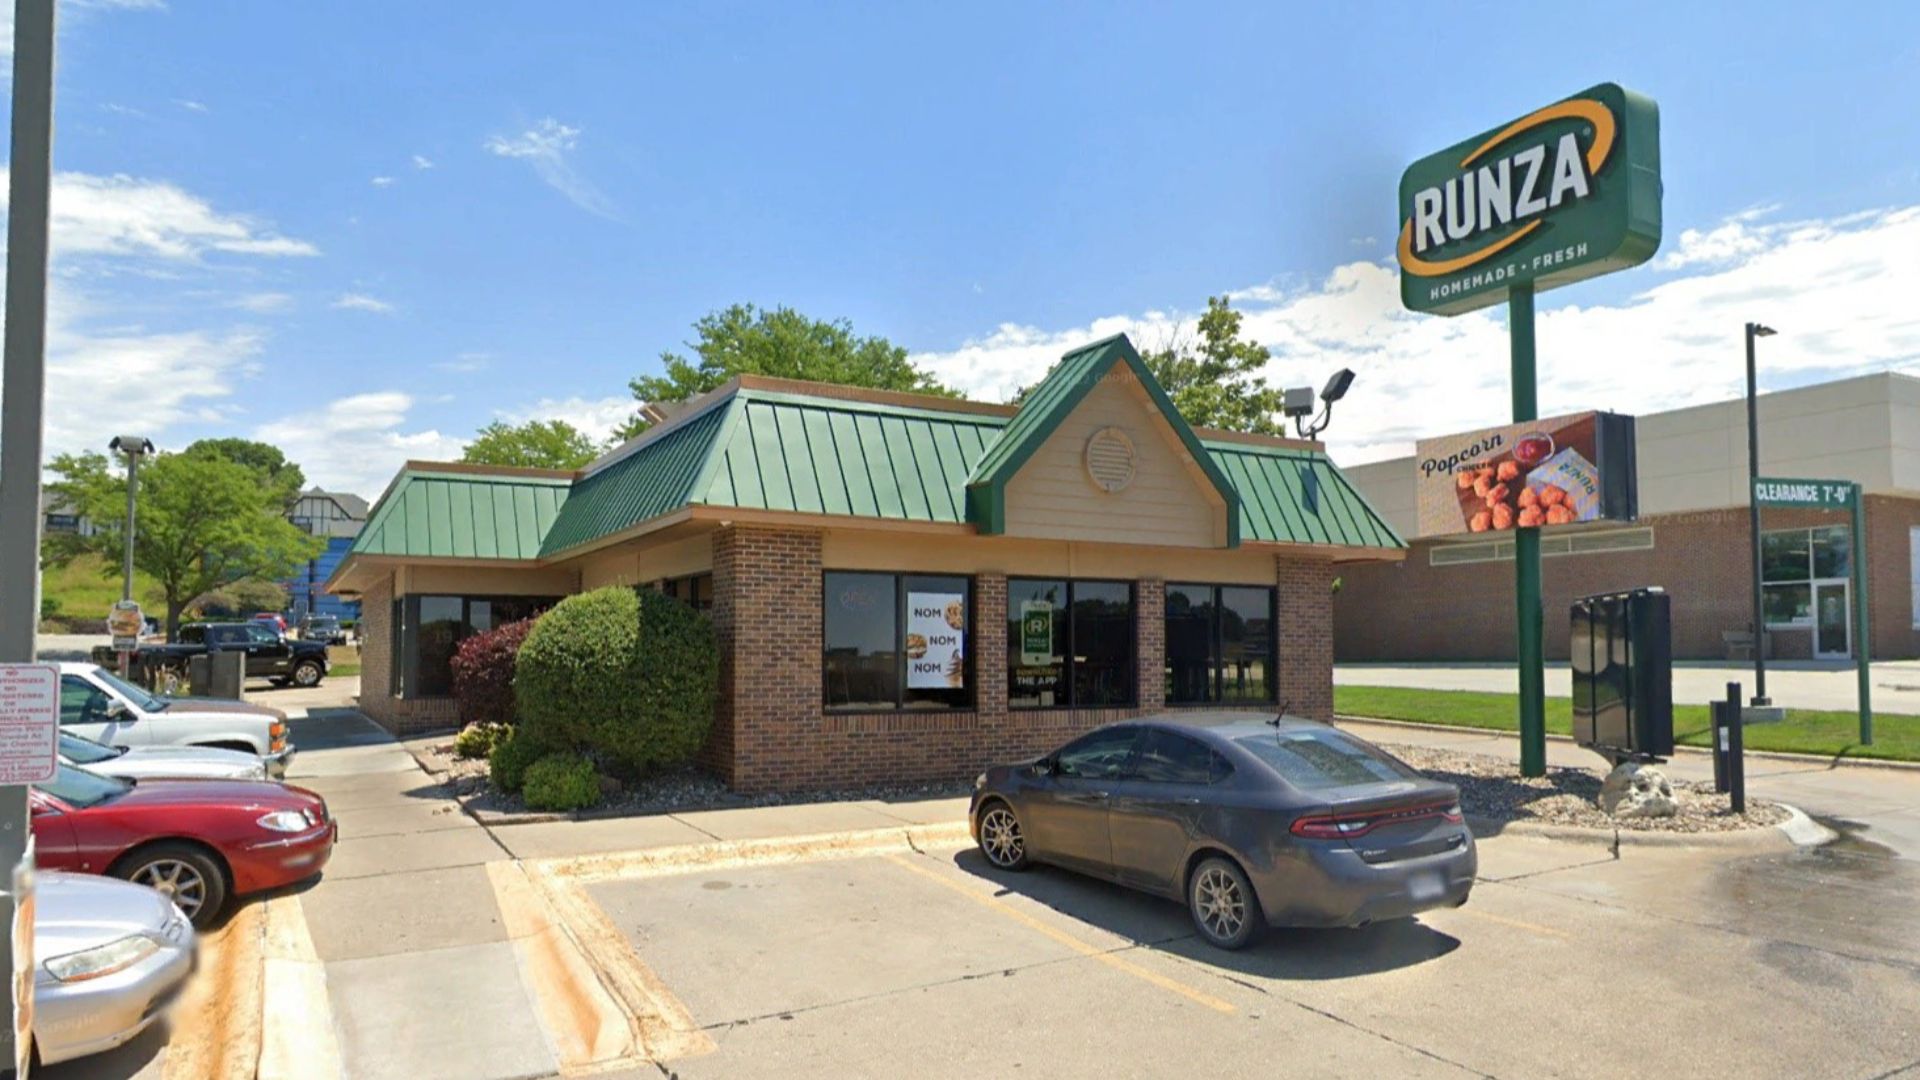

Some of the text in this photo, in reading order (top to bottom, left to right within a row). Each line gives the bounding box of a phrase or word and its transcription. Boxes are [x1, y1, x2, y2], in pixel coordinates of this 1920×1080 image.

[1415, 132, 1590, 252] RUNZA
[1430, 242, 1588, 300] HOMEMADE FRESH
[1421, 433, 1504, 477] Popcorn
[1755, 483, 1819, 502] CLEARANCE
[914, 607, 941, 618] NOM
[929, 635, 956, 646] NOM
[914, 663, 941, 674] NOM
[1017, 676, 1058, 685] THE APP
